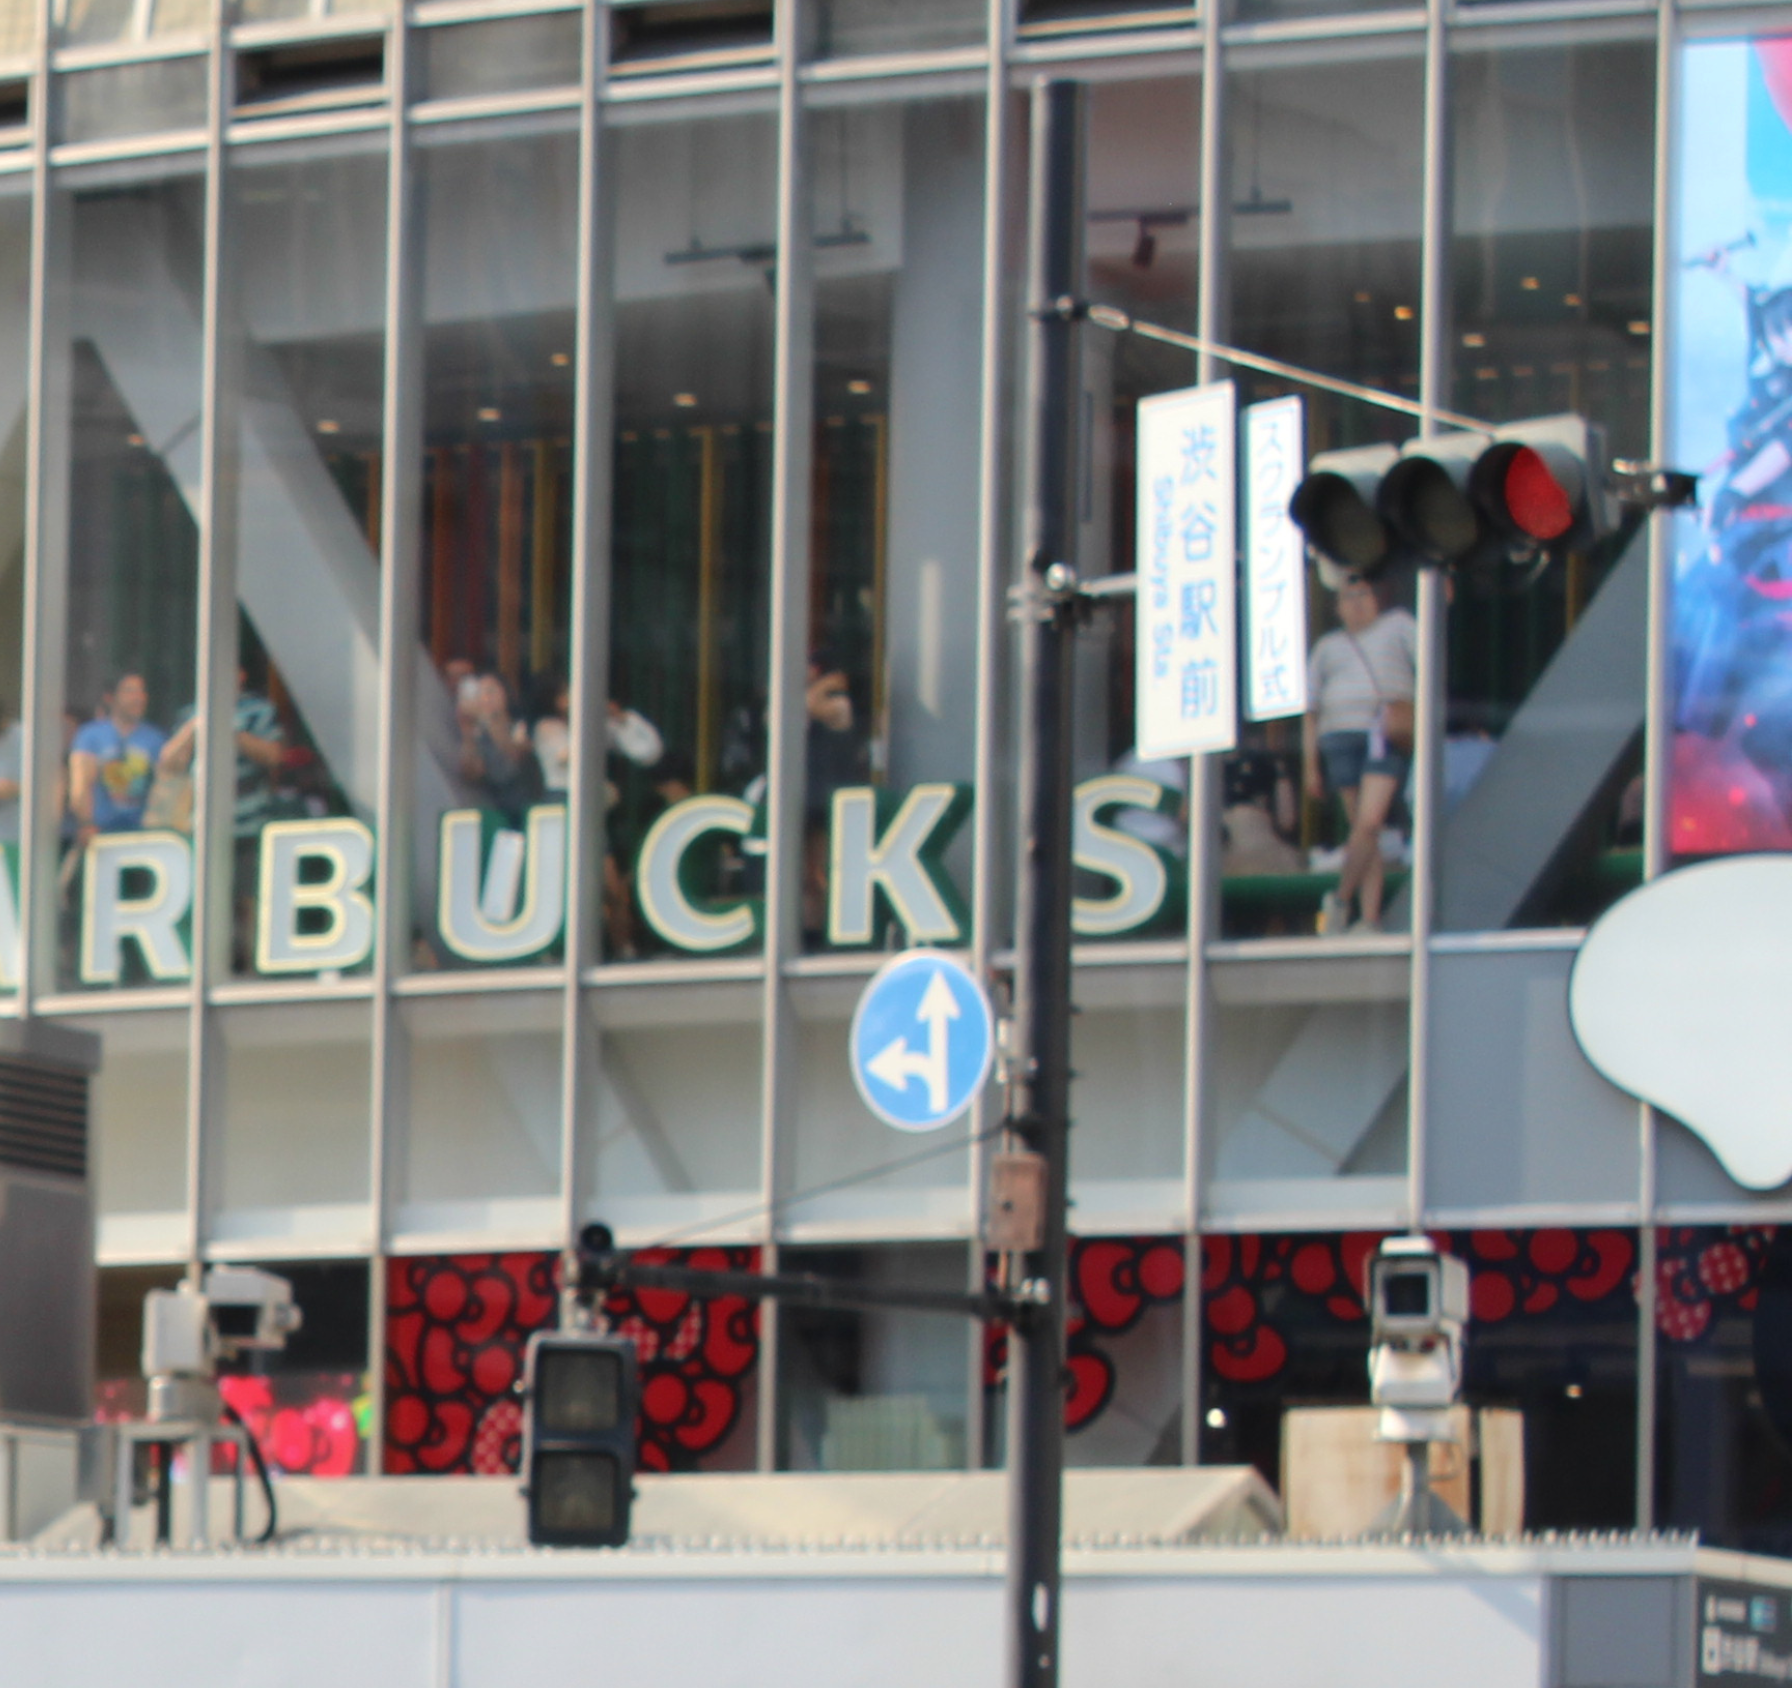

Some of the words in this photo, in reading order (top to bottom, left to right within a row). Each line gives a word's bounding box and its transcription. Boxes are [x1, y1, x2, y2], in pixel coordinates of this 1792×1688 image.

[1150, 475, 1175, 610] Shibuya
[1179, 423, 1219, 718] 渋谷駅前
[1258, 420, 1290, 698] スクランブル式
